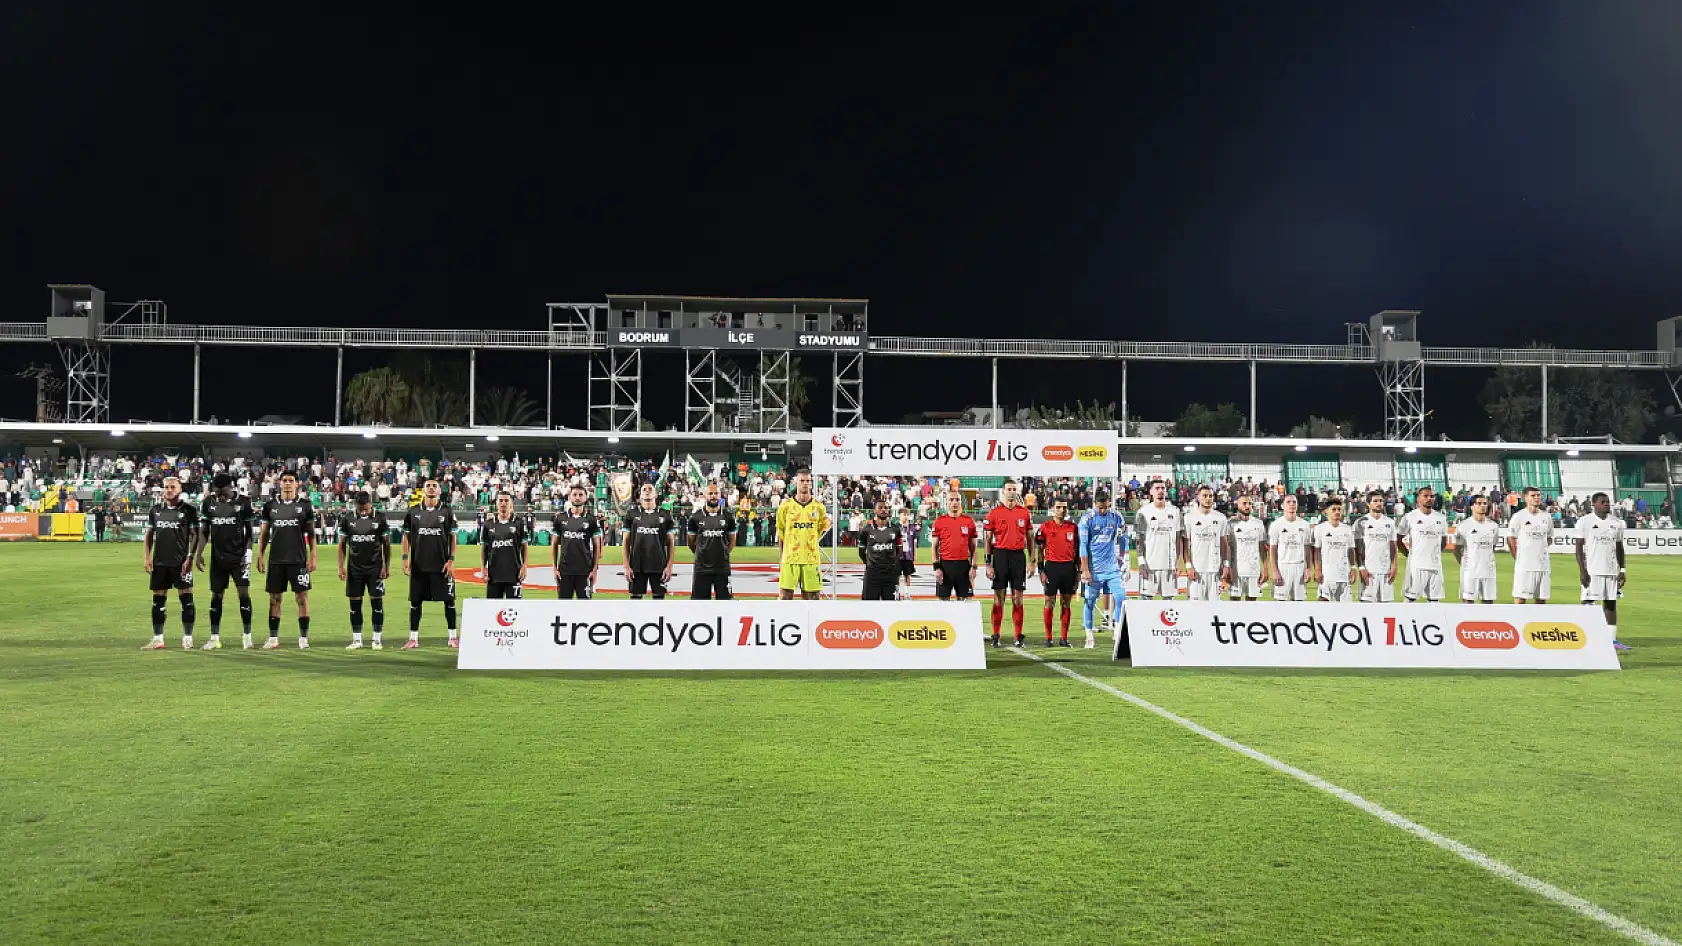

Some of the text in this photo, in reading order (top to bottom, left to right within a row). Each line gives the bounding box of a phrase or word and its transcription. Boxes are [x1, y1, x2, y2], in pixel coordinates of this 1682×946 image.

[619, 331, 860, 346] BODRUM İLÇE STADYUMU
[866, 438, 977, 465] trendyol
[484, 629, 529, 639] trendyol
[550, 616, 722, 652] trendyol
[821, 628, 878, 640] trendyol
[1151, 628, 1193, 638] trendyol
[1211, 615, 1372, 651] trendyol
[1461, 629, 1515, 642] trendyol
